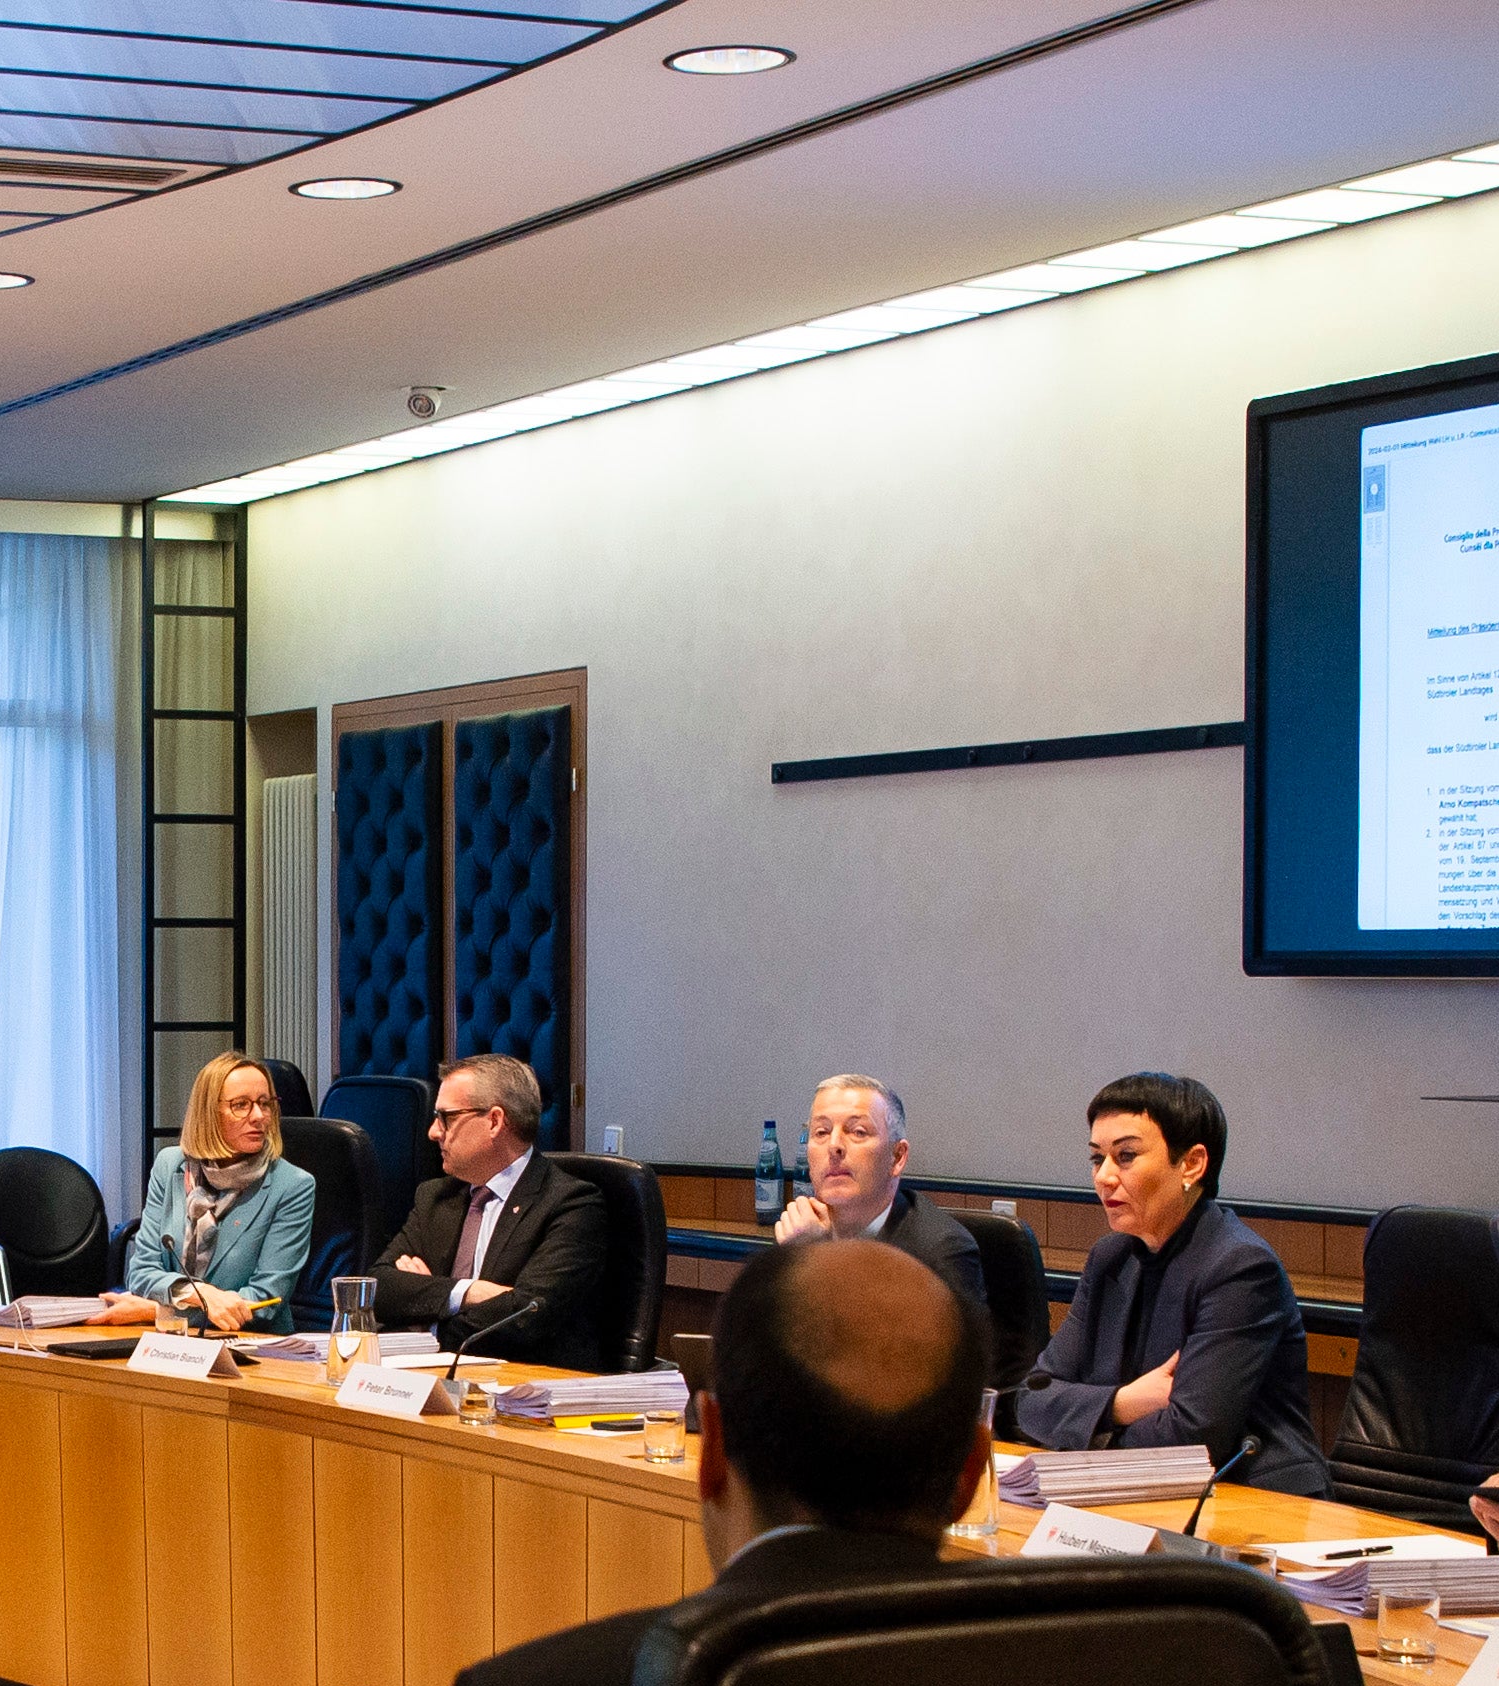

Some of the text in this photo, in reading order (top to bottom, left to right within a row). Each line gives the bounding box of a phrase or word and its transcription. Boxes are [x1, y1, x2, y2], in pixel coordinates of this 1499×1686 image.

[1444, 531, 1473, 543] Consiglio
[1475, 529, 1490, 538] della
[150, 1348, 206, 1364] Christian Bianchi
[364, 1381, 413, 1400] Peter Brunner
[1057, 1531, 1088, 1550] Hubert
